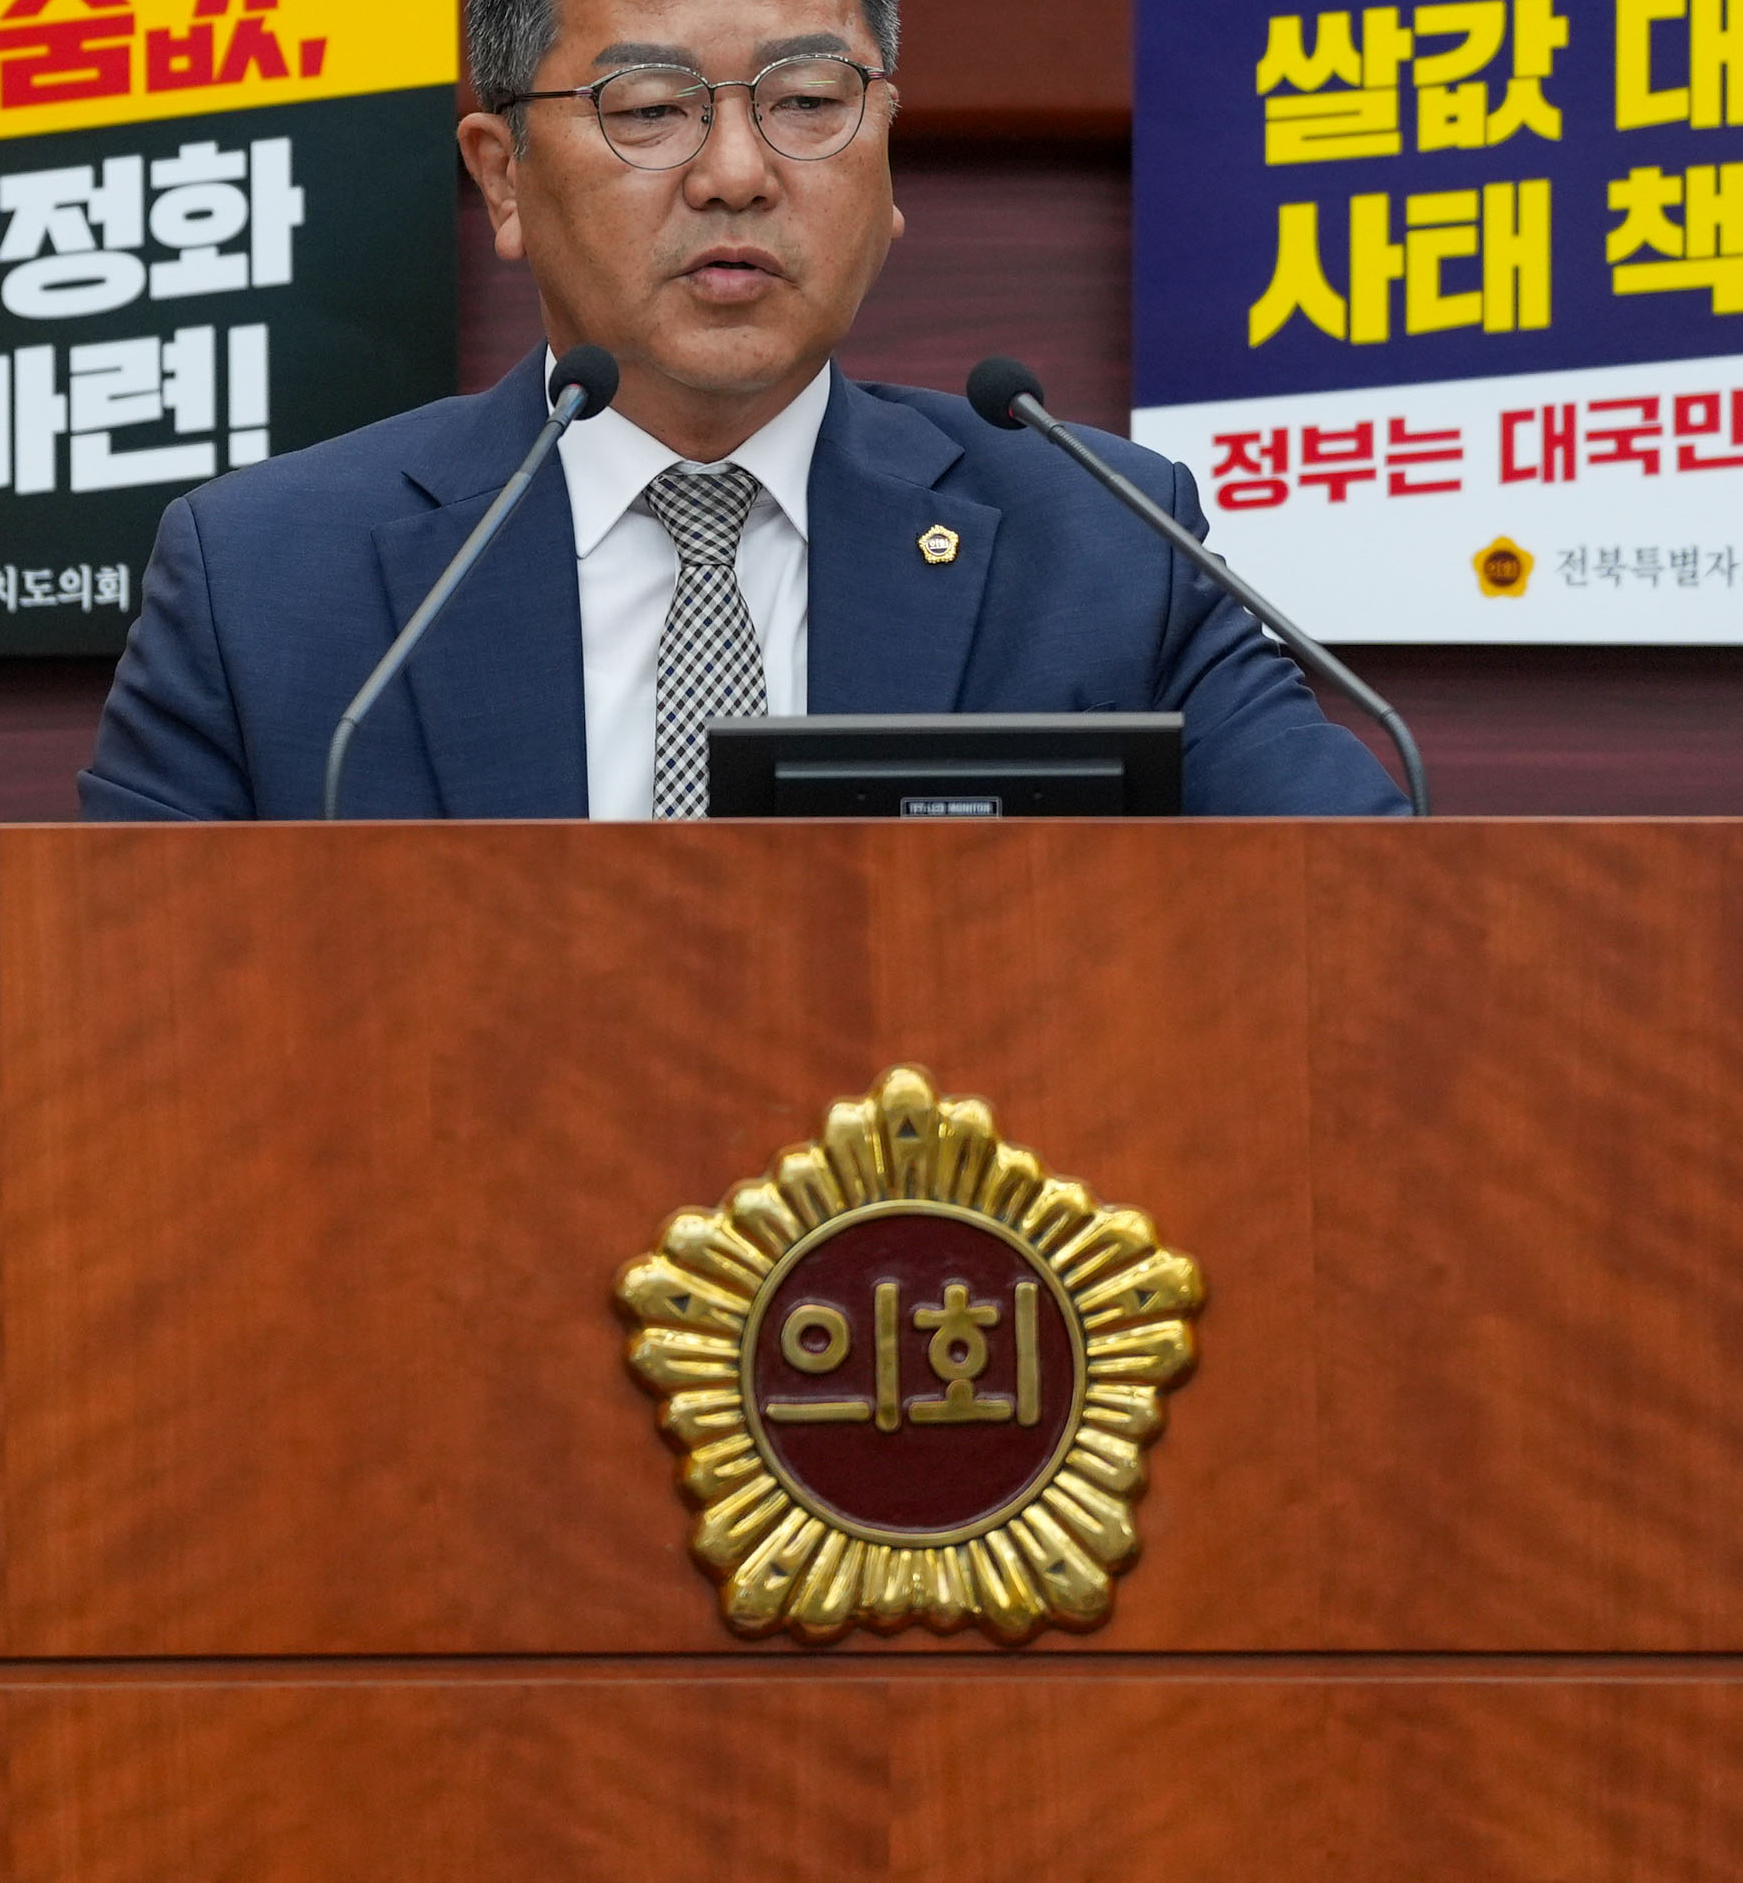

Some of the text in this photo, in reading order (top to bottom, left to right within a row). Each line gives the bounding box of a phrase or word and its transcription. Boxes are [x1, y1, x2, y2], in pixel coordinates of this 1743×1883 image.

[1248, 178, 1552, 349] 사태
[1212, 417, 1464, 512] 정부는
[764, 1280, 1041, 1433] 의회
